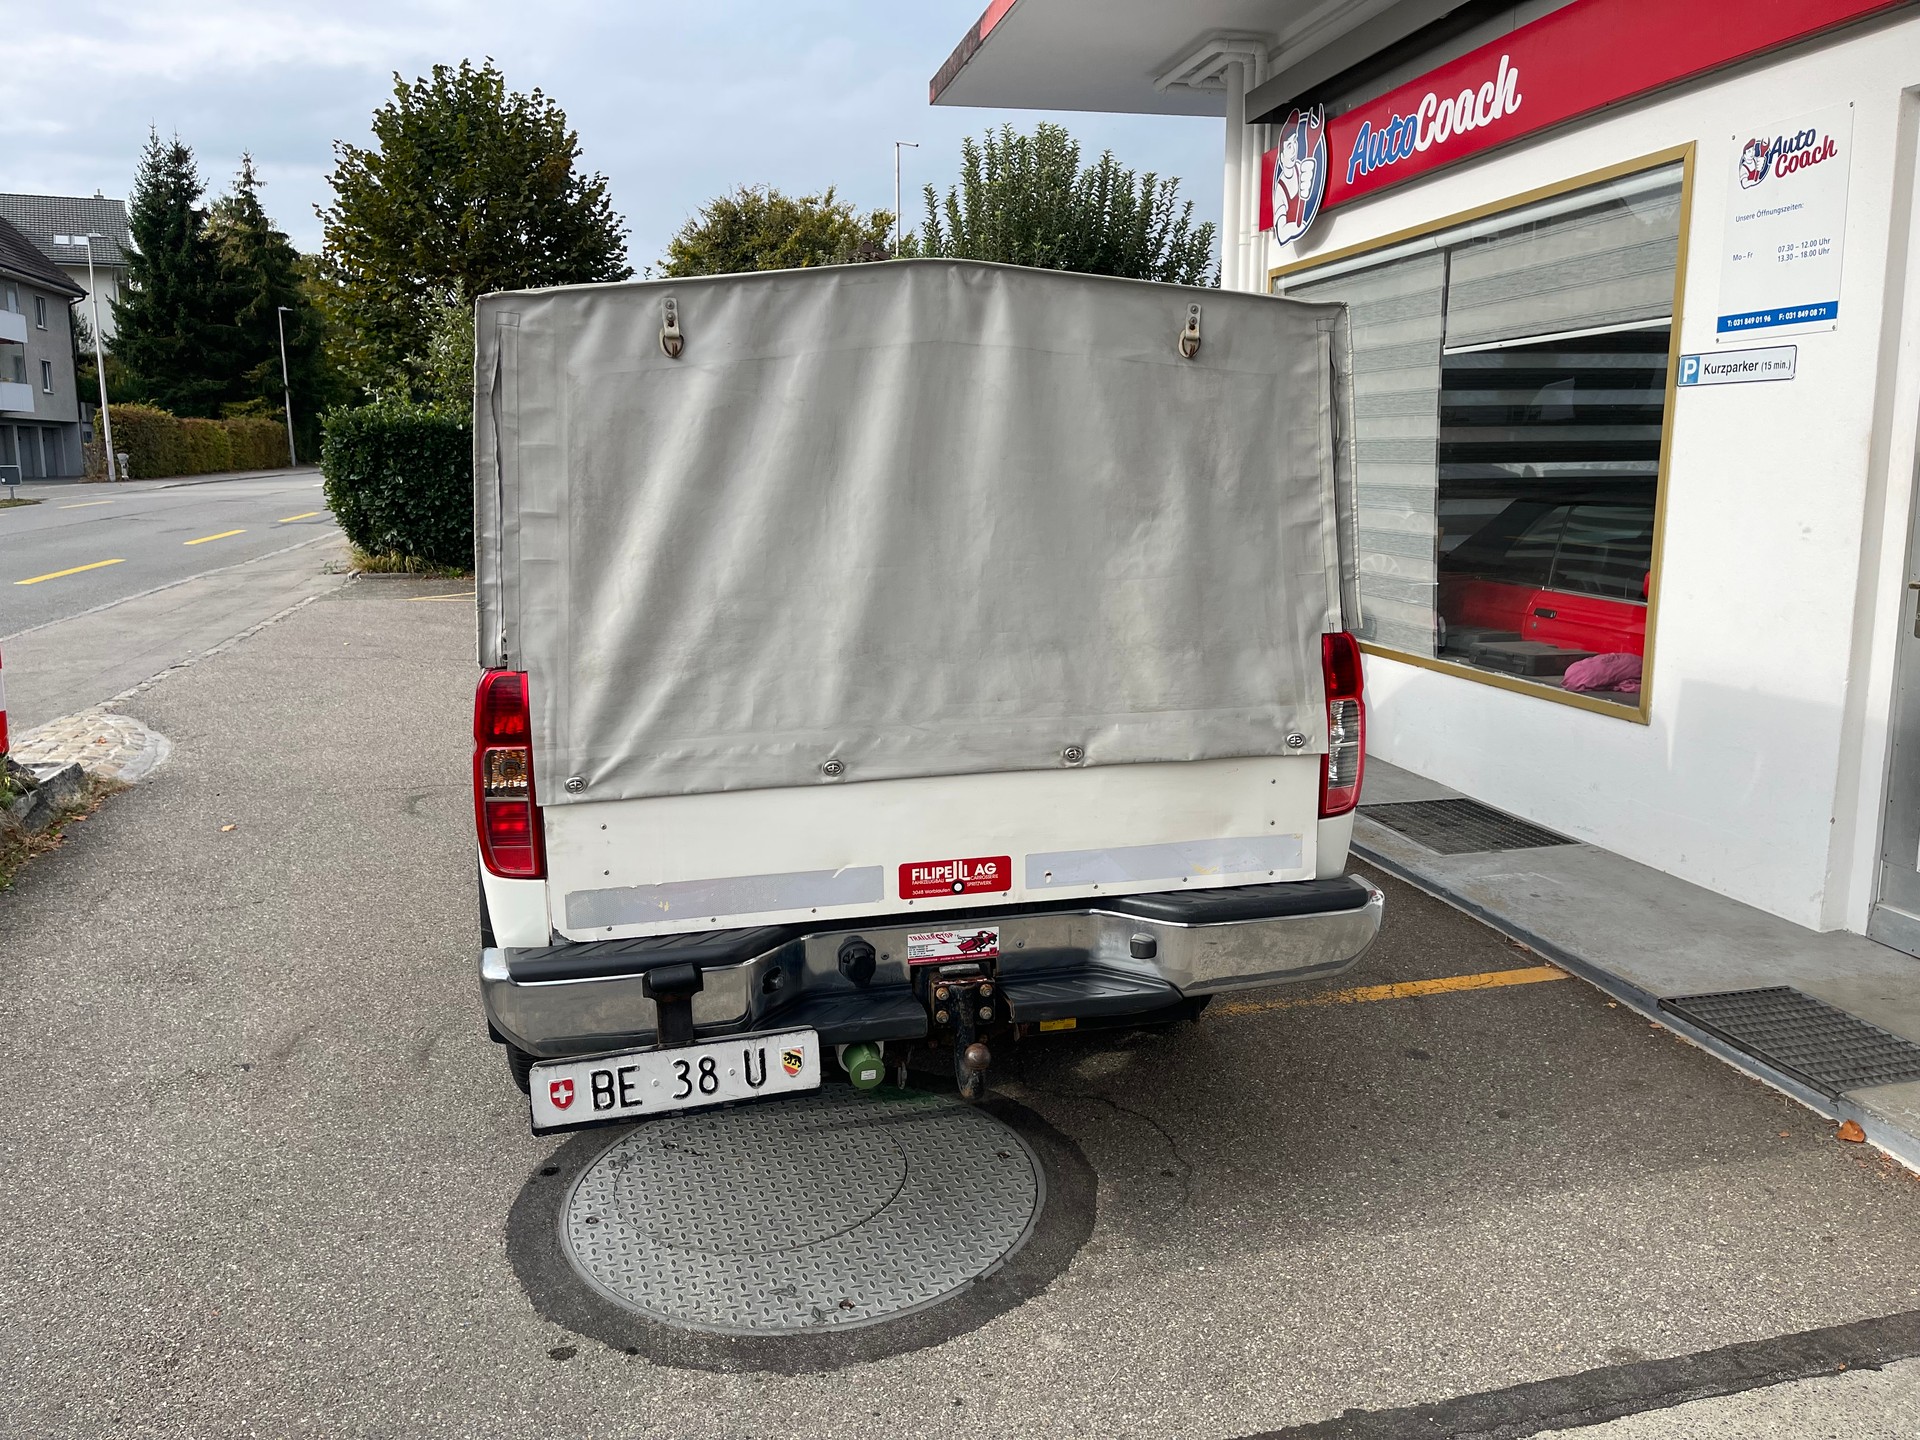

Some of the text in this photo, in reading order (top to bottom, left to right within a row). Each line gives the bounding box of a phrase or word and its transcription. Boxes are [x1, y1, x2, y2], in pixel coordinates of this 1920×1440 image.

[1346, 54, 1522, 184] AutoCoach
[1768, 127, 1817, 164] Auto
[1774, 134, 1838, 179] Coach
[1735, 202, 1805, 223] Unsere Öffnungszeiten:
[1777, 243, 1795, 254] 07.30
[1801, 239, 1818, 249] 12.00
[1818, 237, 1831, 246] Uhr
[1777, 253, 1794, 263] 13.30
[1800, 248, 1817, 259] 18.00
[1818, 247, 1830, 256] Uhr
[1732, 254, 1743, 262] Mo
[1747, 251, 1754, 259] Fr
[1733, 318, 1743, 326] 031
[1744, 317, 1755, 325] 849
[1755, 316, 1763, 324] 01
[1764, 315, 1771, 323] 96
[1785, 311, 1796, 320] 031
[1797, 310, 1809, 318] 849
[1818, 307, 1827, 316] 71
[1682, 359, 1792, 383] P Kurzparker (15 min.)
[974, 862, 997, 876] AG
[589, 1048, 767, 1112] BE 38 U
